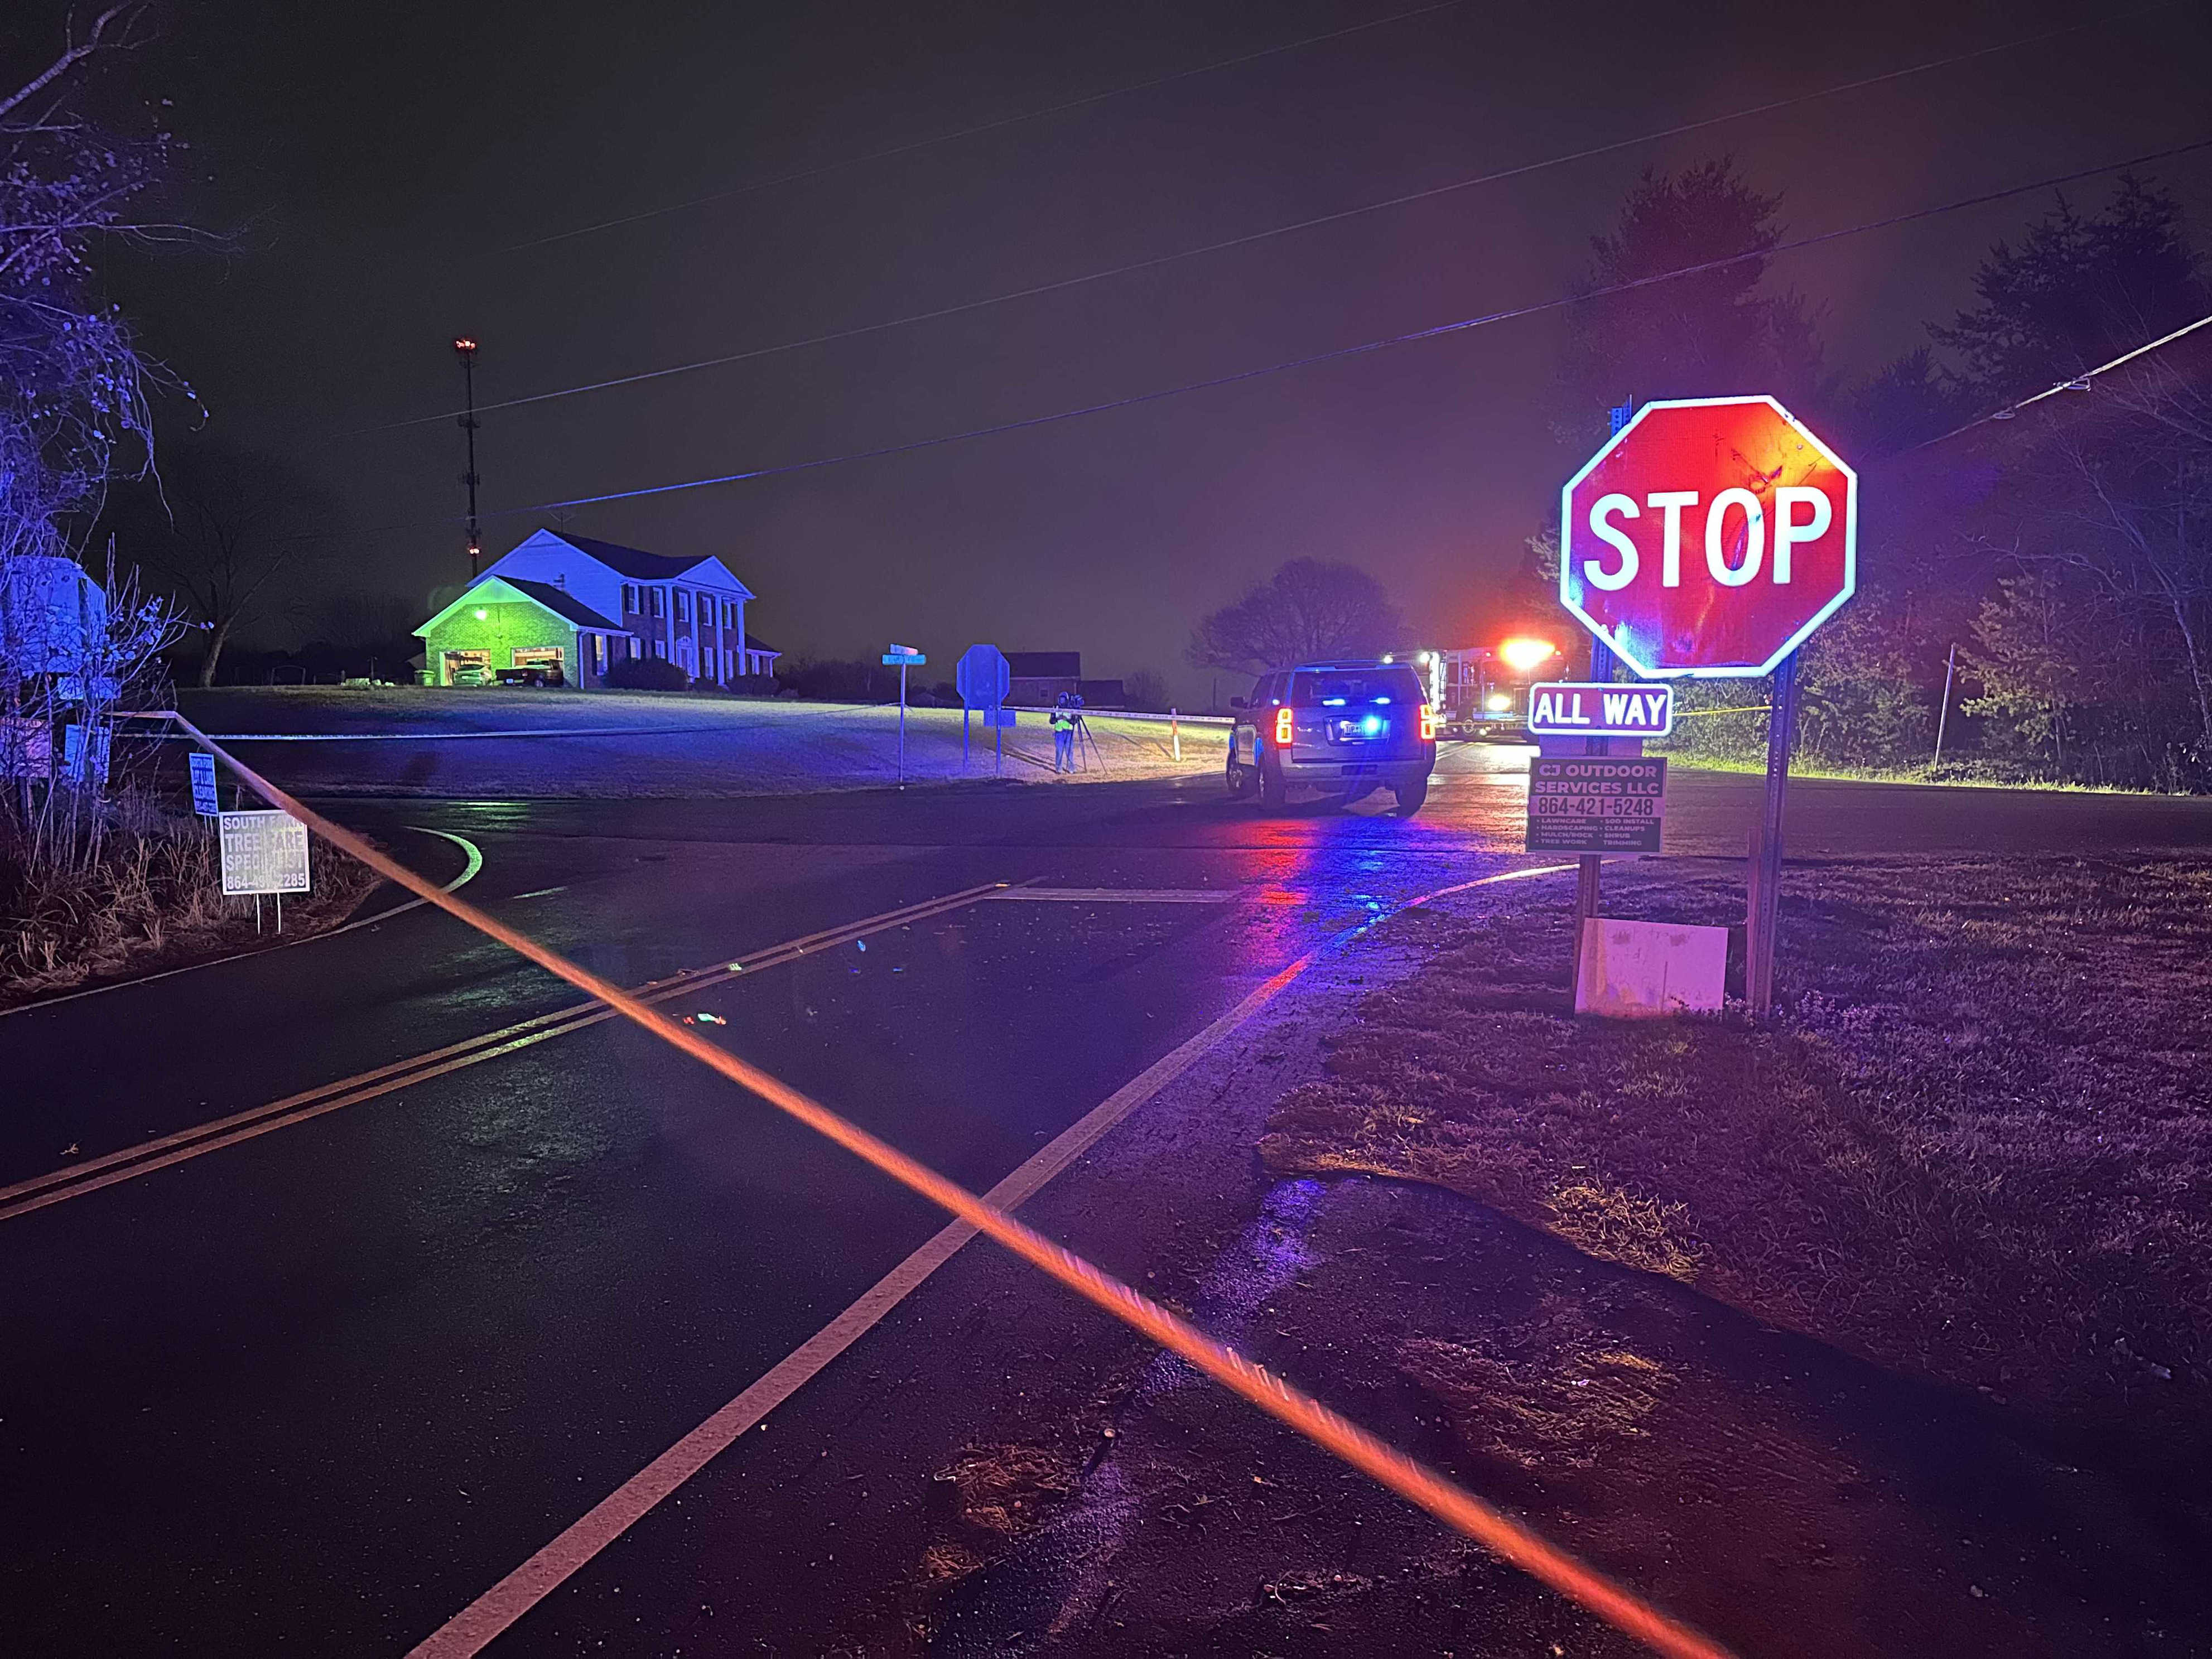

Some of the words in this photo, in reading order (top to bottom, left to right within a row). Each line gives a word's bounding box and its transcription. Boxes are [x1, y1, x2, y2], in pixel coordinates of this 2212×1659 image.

[1584, 486, 1832, 591] STOP
[1534, 692, 1591, 725] ALL
[1603, 693, 1667, 726] WAY
[1539, 764, 1561, 777] CJ
[1565, 765, 1657, 777] OUTDOOR
[1535, 781, 1622, 794] SERVICES
[1627, 782, 1660, 794] LLC
[1538, 797, 1654, 816] 864-421-5248
[224, 816, 266, 830] SOUTH
[225, 833, 263, 852] TREE
[226, 852, 302, 871] SPECIST
